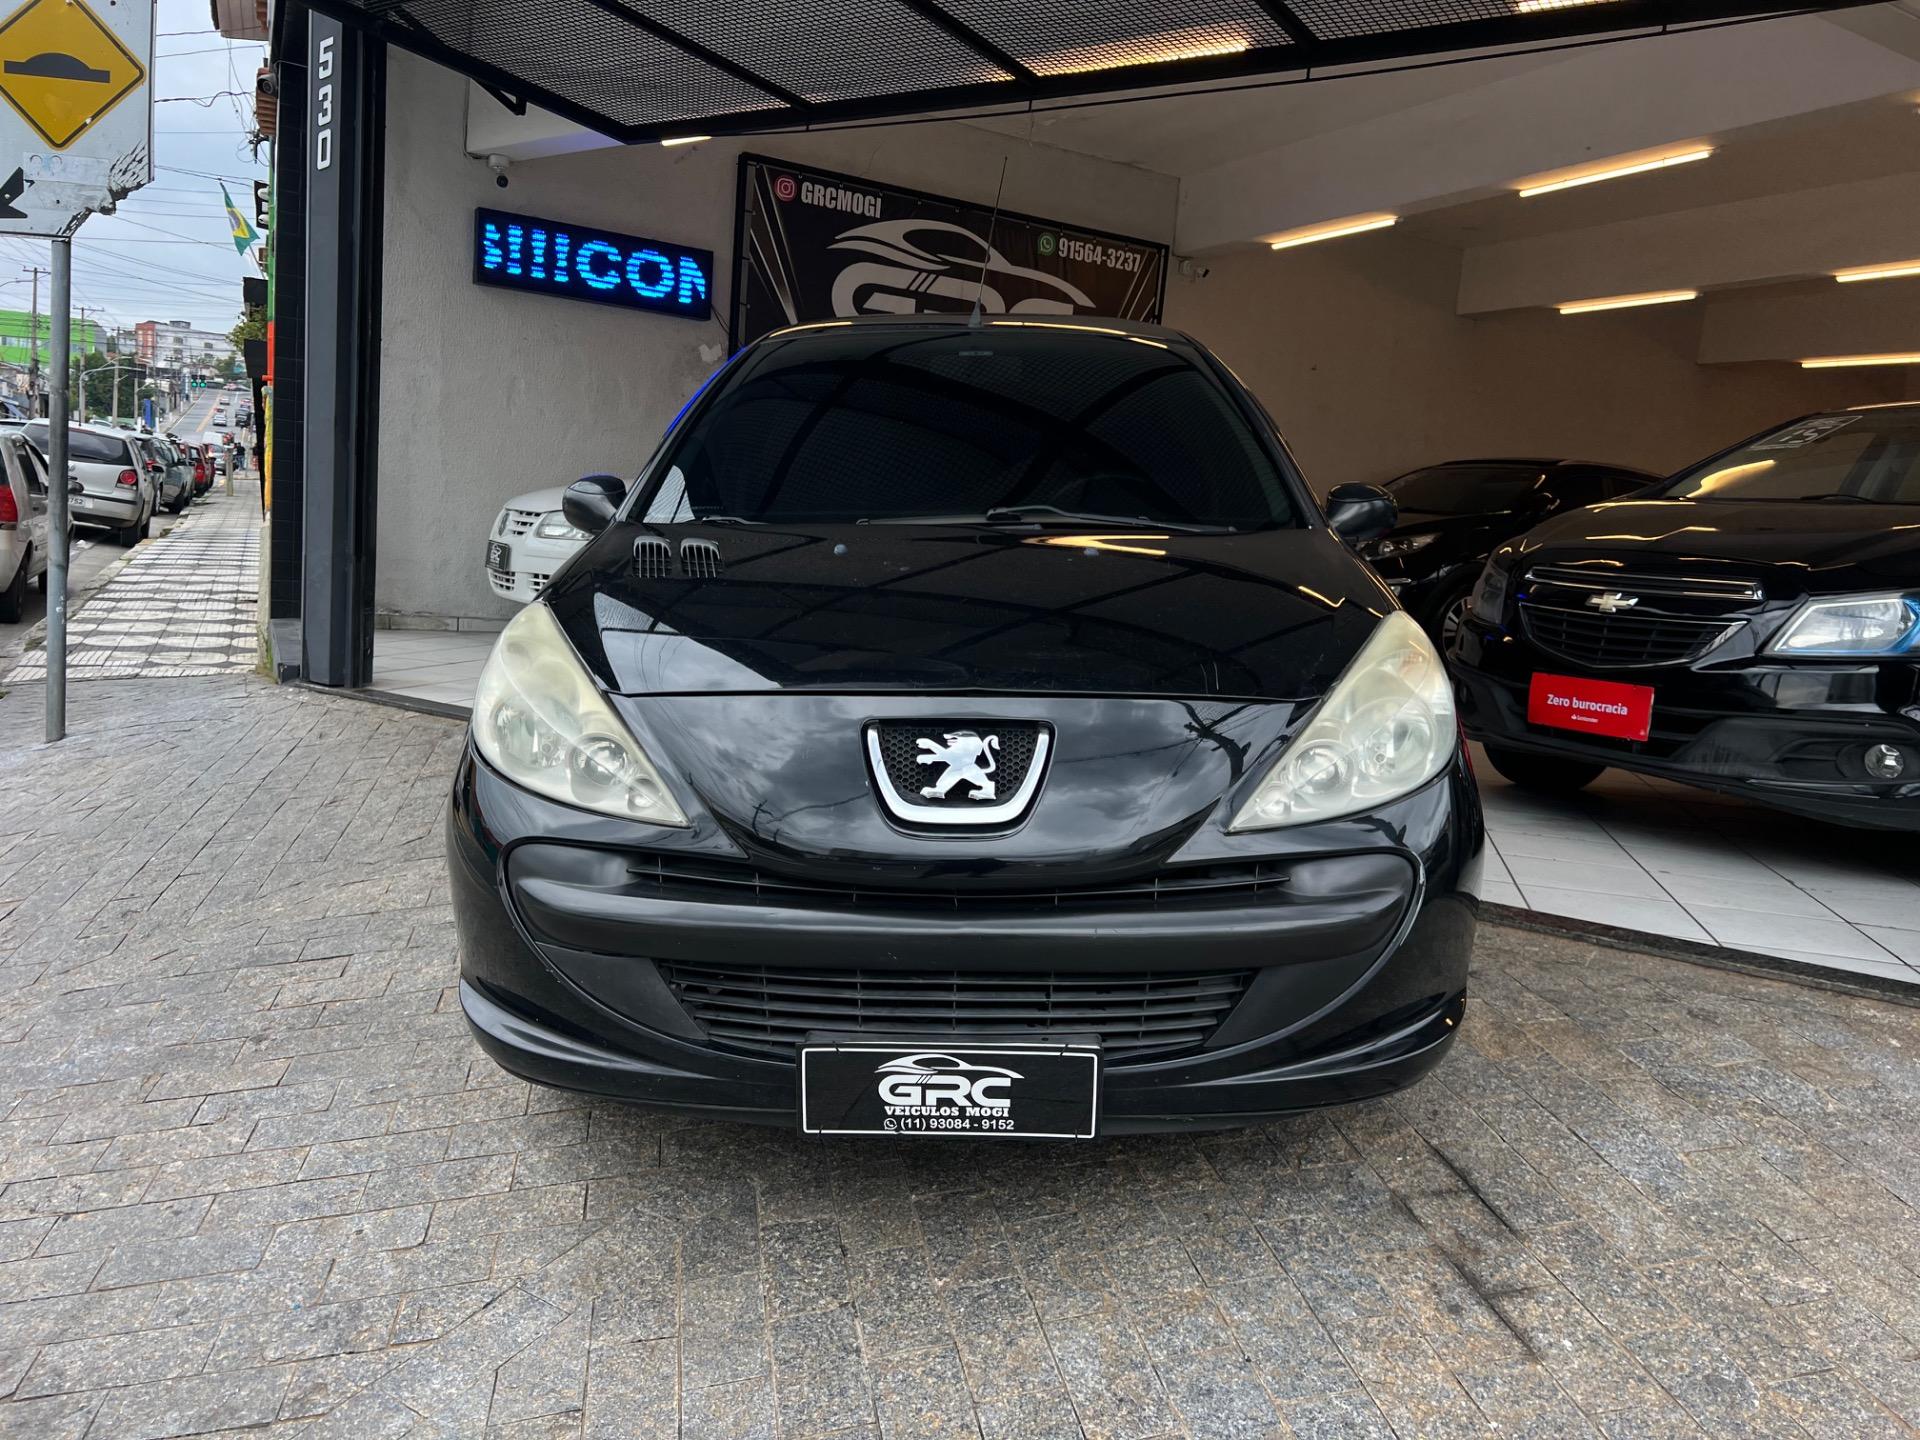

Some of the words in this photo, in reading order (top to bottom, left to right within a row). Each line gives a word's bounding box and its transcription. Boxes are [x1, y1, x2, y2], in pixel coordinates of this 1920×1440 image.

[317, 36, 334, 170] 530
[801, 181, 882, 219] GRCMOGI
[1059, 237, 1141, 273] 91564-3237
[1547, 693, 1570, 707] Zero
[1572, 697, 1628, 715] burocracia
[878, 1074, 1011, 1107] GRC
[884, 1105, 960, 1116] VEICULOS
[965, 1107, 1010, 1117] MOGI
[900, 1118, 927, 1131] (11)
[929, 1119, 971, 1129] 93084
[981, 1119, 1015, 1130] 9152
